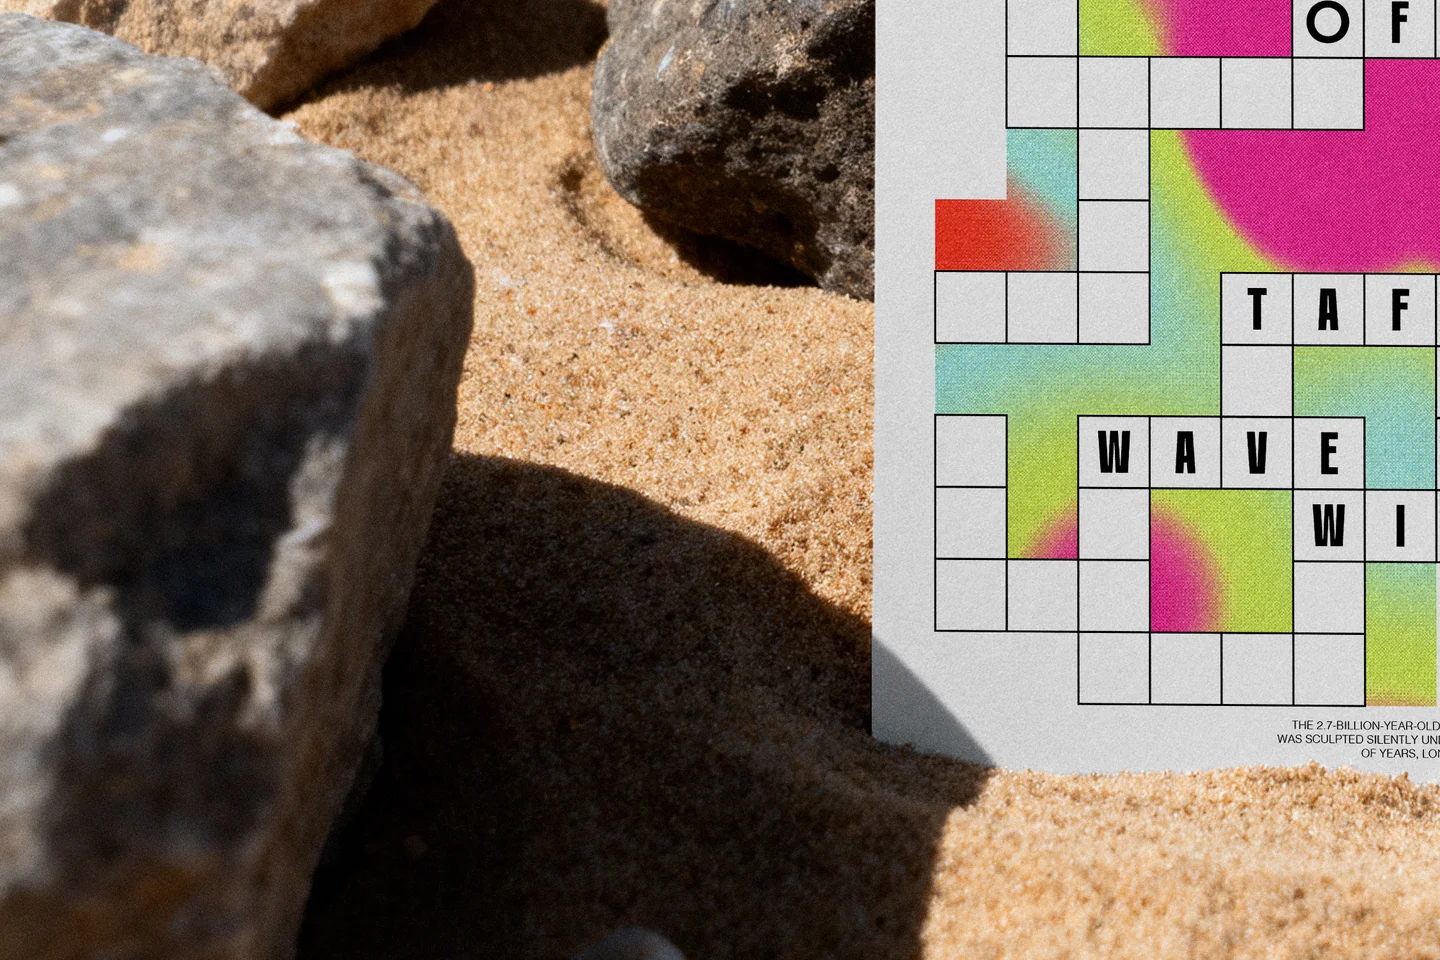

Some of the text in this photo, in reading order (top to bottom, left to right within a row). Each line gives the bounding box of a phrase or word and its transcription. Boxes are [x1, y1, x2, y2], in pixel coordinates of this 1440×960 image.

[1307, 1, 1409, 44] OF
[1098, 431, 1338, 474] WAVE
[1292, 719, 1313, 730] THE
[1316, 719, 1440, 732] 2.7-BILLION-YEAR-OLD
[1361, 747, 1376, 759] OF
[1379, 748, 1419, 760] YEARS,
